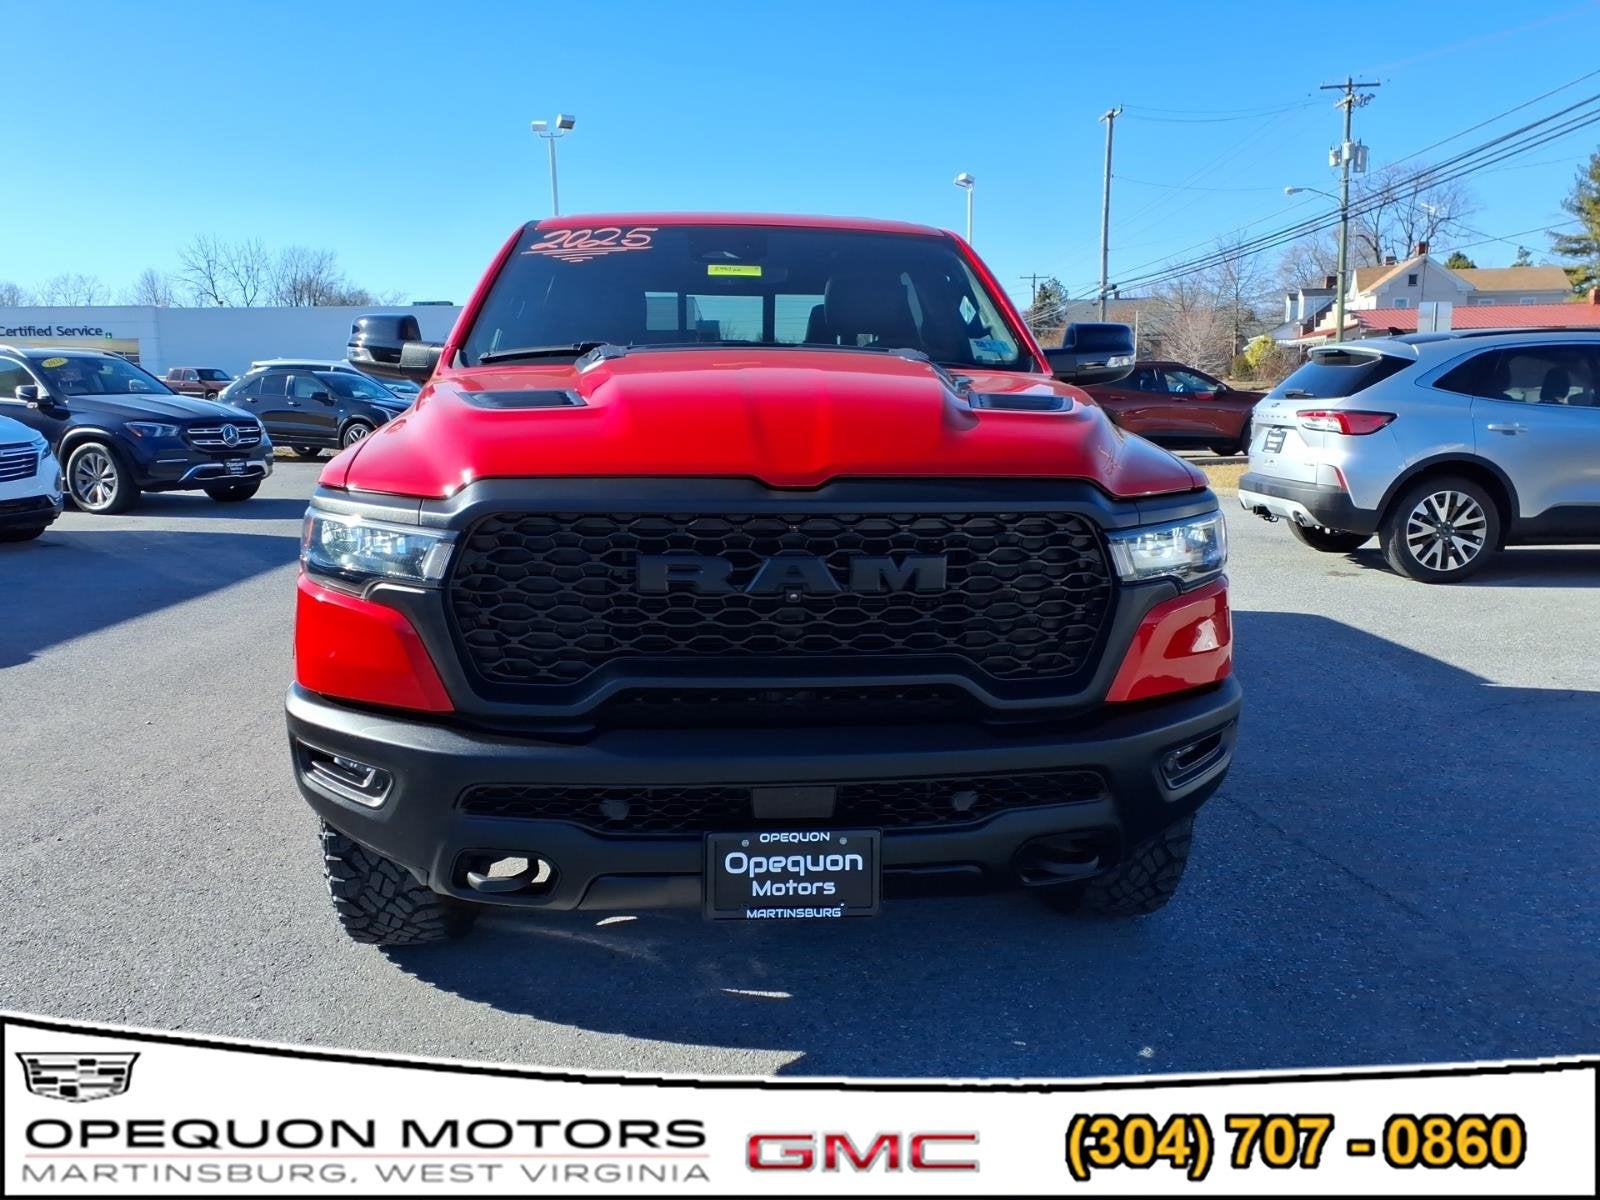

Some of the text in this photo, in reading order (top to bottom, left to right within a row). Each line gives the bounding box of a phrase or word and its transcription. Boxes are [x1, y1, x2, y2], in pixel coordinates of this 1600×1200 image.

[530, 227, 659, 250] 2025
[0, 326, 103, 337] Certified Service
[637, 554, 948, 593] RAM
[759, 832, 830, 843] OPEQUON
[724, 852, 863, 878] Opequon
[752, 879, 836, 897] Motors
[746, 907, 841, 919] MARTINSBURG
